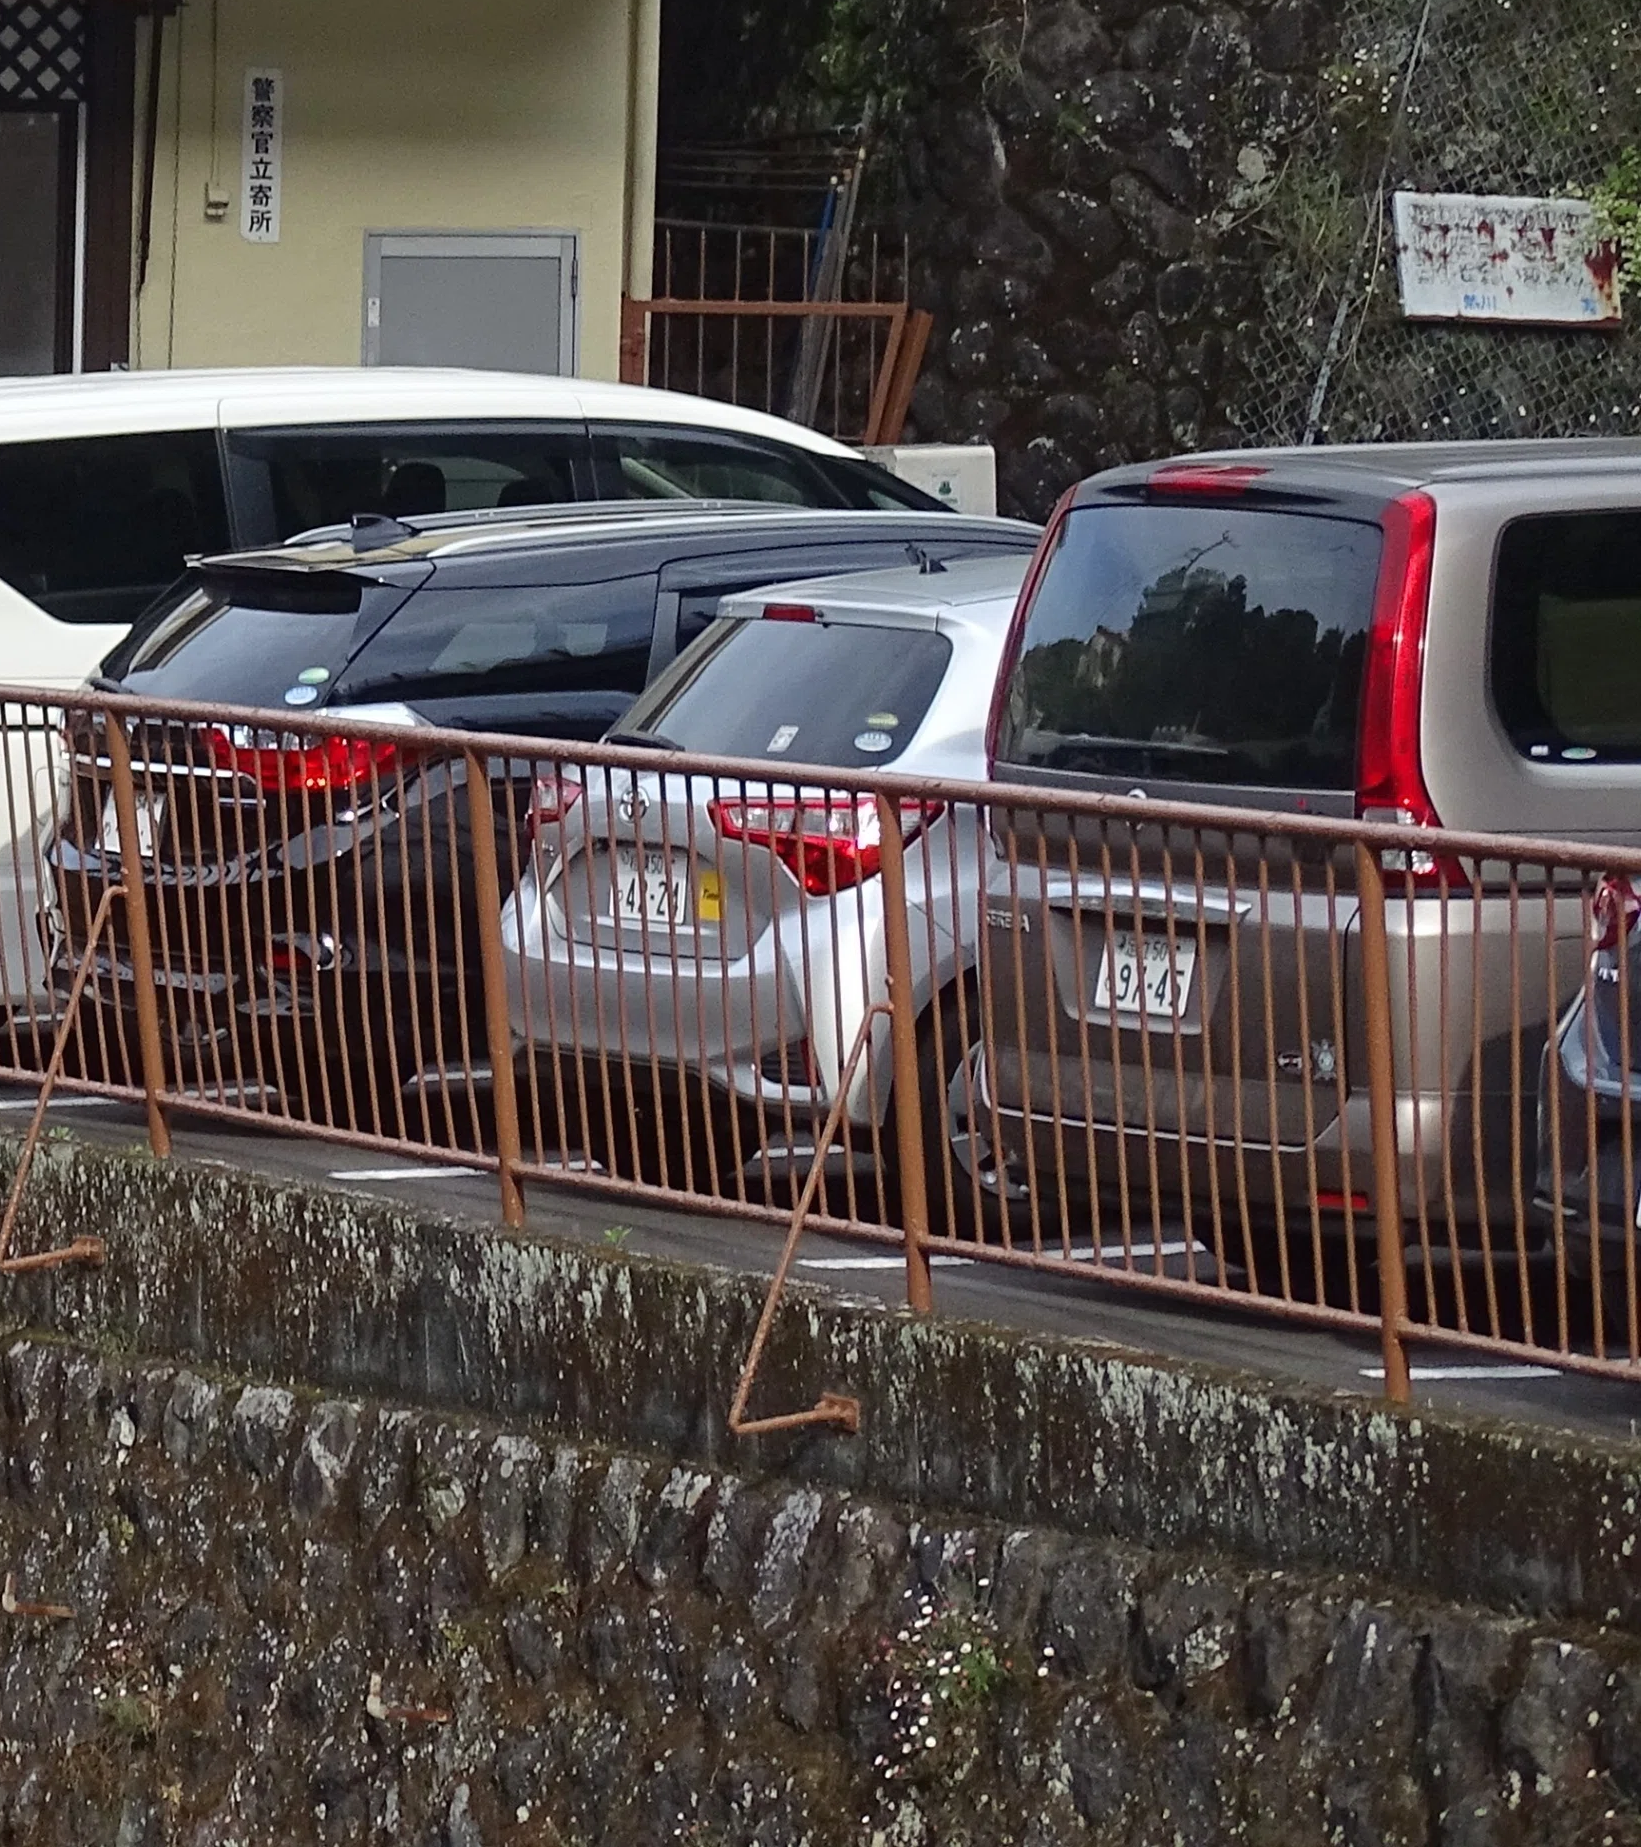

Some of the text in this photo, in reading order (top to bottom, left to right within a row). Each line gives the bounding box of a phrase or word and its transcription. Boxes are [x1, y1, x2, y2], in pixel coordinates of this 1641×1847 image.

[248, 76, 275, 233] 警察官立寄所
